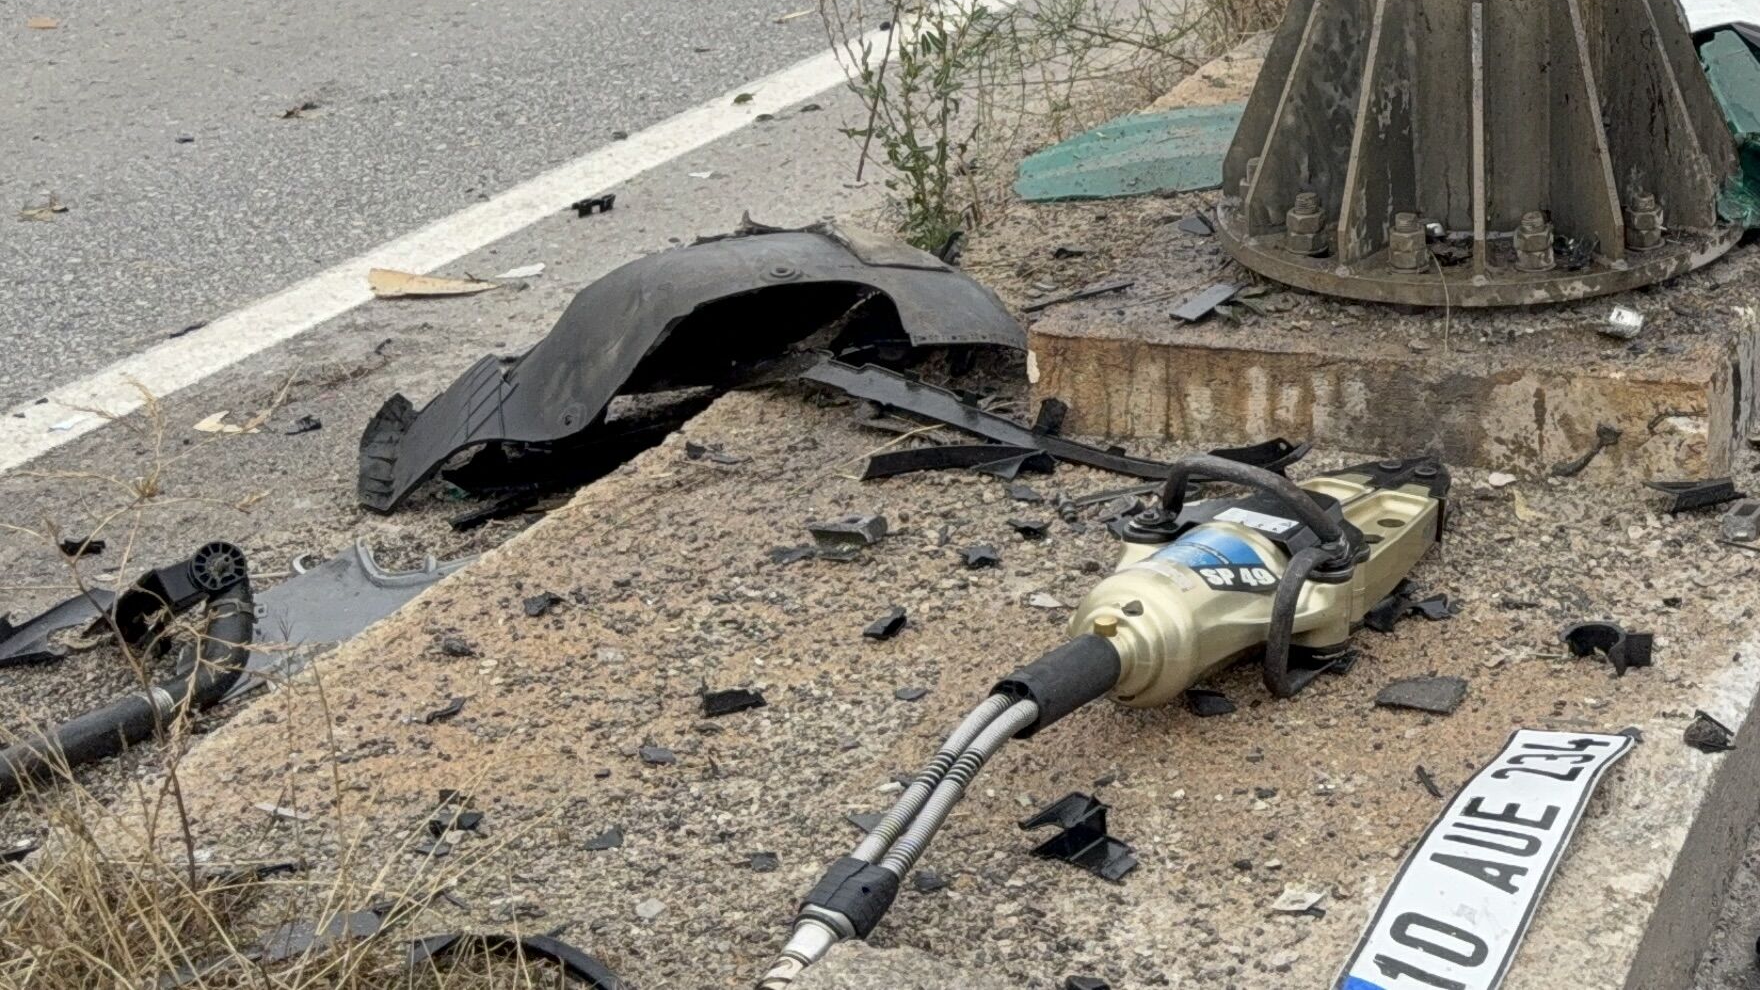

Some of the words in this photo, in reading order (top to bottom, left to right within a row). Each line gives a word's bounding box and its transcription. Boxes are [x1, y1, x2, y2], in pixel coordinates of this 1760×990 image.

[1199, 567, 1235, 586] SP
[1239, 567, 1276, 587] 49
[1491, 738, 1611, 782] 234
[1429, 796, 1561, 895] AUE
[1373, 911, 1489, 990] 10
